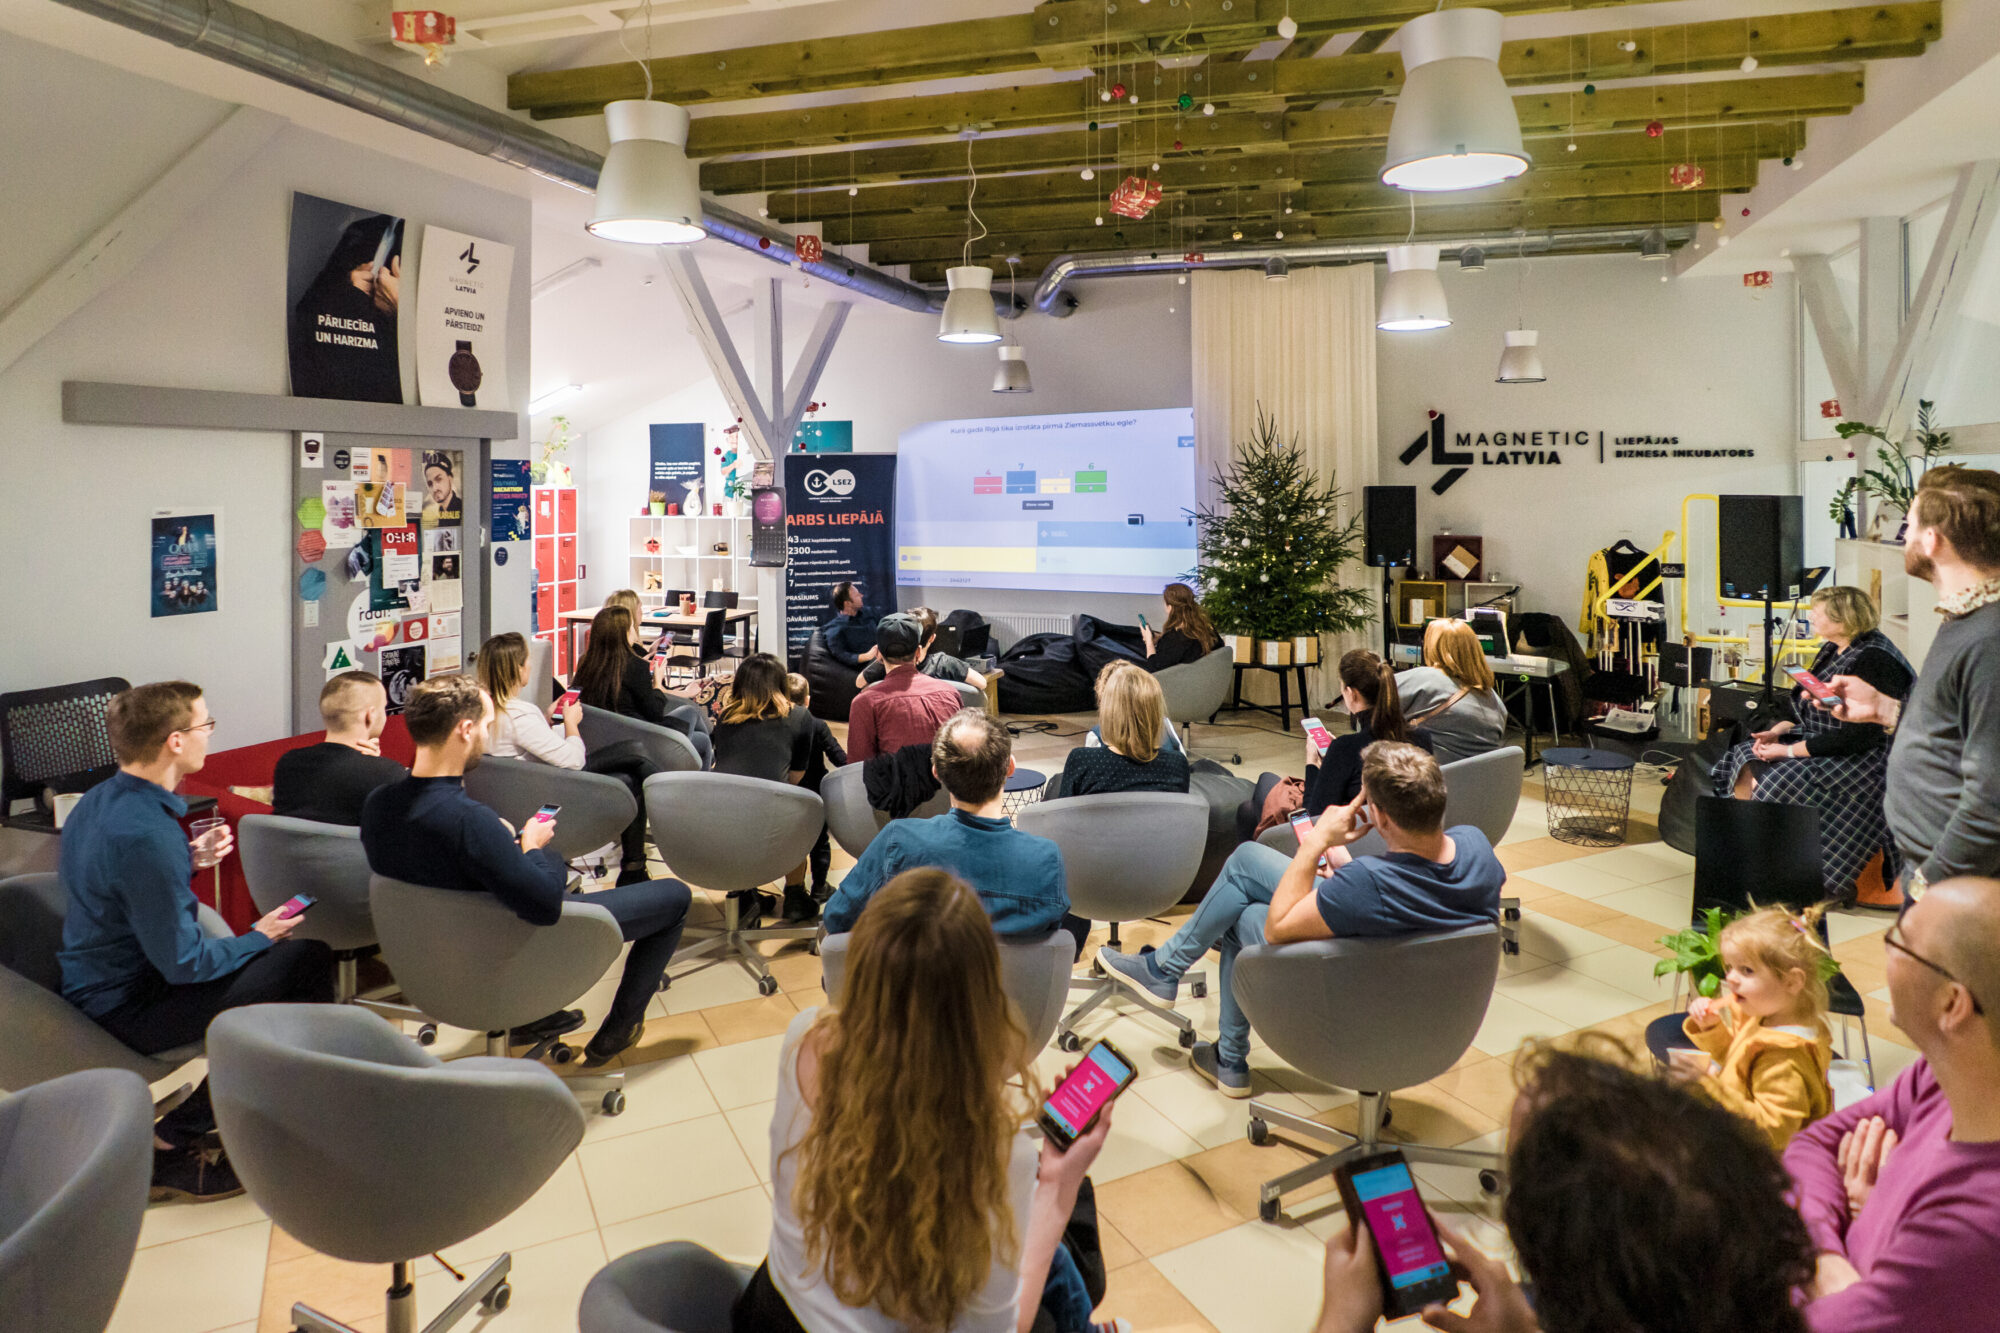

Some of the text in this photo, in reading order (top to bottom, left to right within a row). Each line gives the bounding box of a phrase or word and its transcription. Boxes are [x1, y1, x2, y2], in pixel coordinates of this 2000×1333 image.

[455, 285, 477, 294] LATVIA
[444, 307, 485, 321] APVIENO UN
[317, 314, 376, 333] PĀRLIECĪBA
[445, 319, 483, 332] PĀRSTEIDZ!
[315, 331, 379, 350] UN HARIZMA
[1116, 418, 1137, 428] egle?
[1455, 431, 1590, 447] MAGNETIC
[1615, 435, 1679, 445] LIEPĀJAS
[1482, 451, 1562, 465] LATVIA
[1615, 448, 1755, 459] BIZNESA INKUBATORS
[832, 478, 852, 486] LSEZ
[828, 510, 885, 525] LIEPĀJĀ
[788, 535, 799, 543] 43
[788, 579, 794, 587] 7
